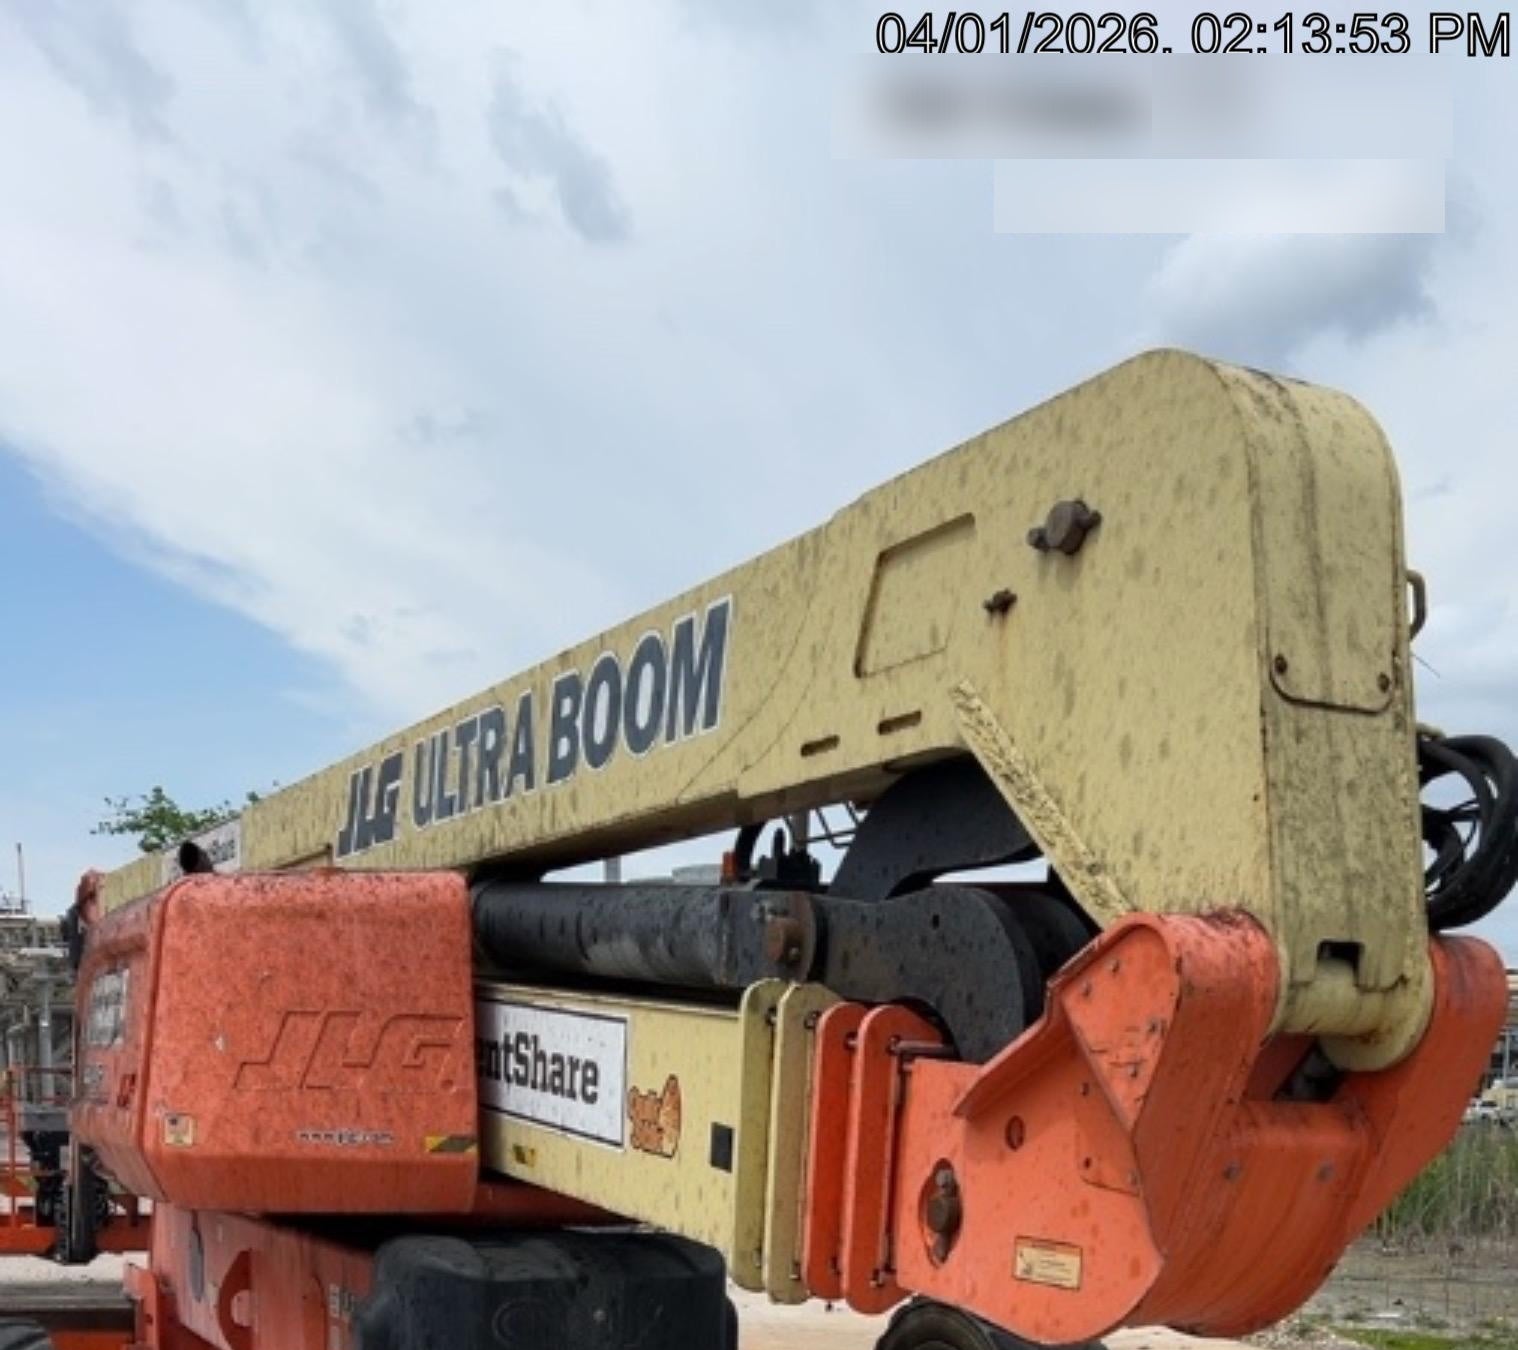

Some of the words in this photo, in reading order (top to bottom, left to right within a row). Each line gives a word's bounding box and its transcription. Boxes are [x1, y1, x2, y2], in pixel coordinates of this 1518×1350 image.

[336, 752, 402, 858] JLG
[412, 690, 537, 830] ULTRA
[546, 594, 733, 786] BOOM
[231, 1010, 464, 1091] JLG
